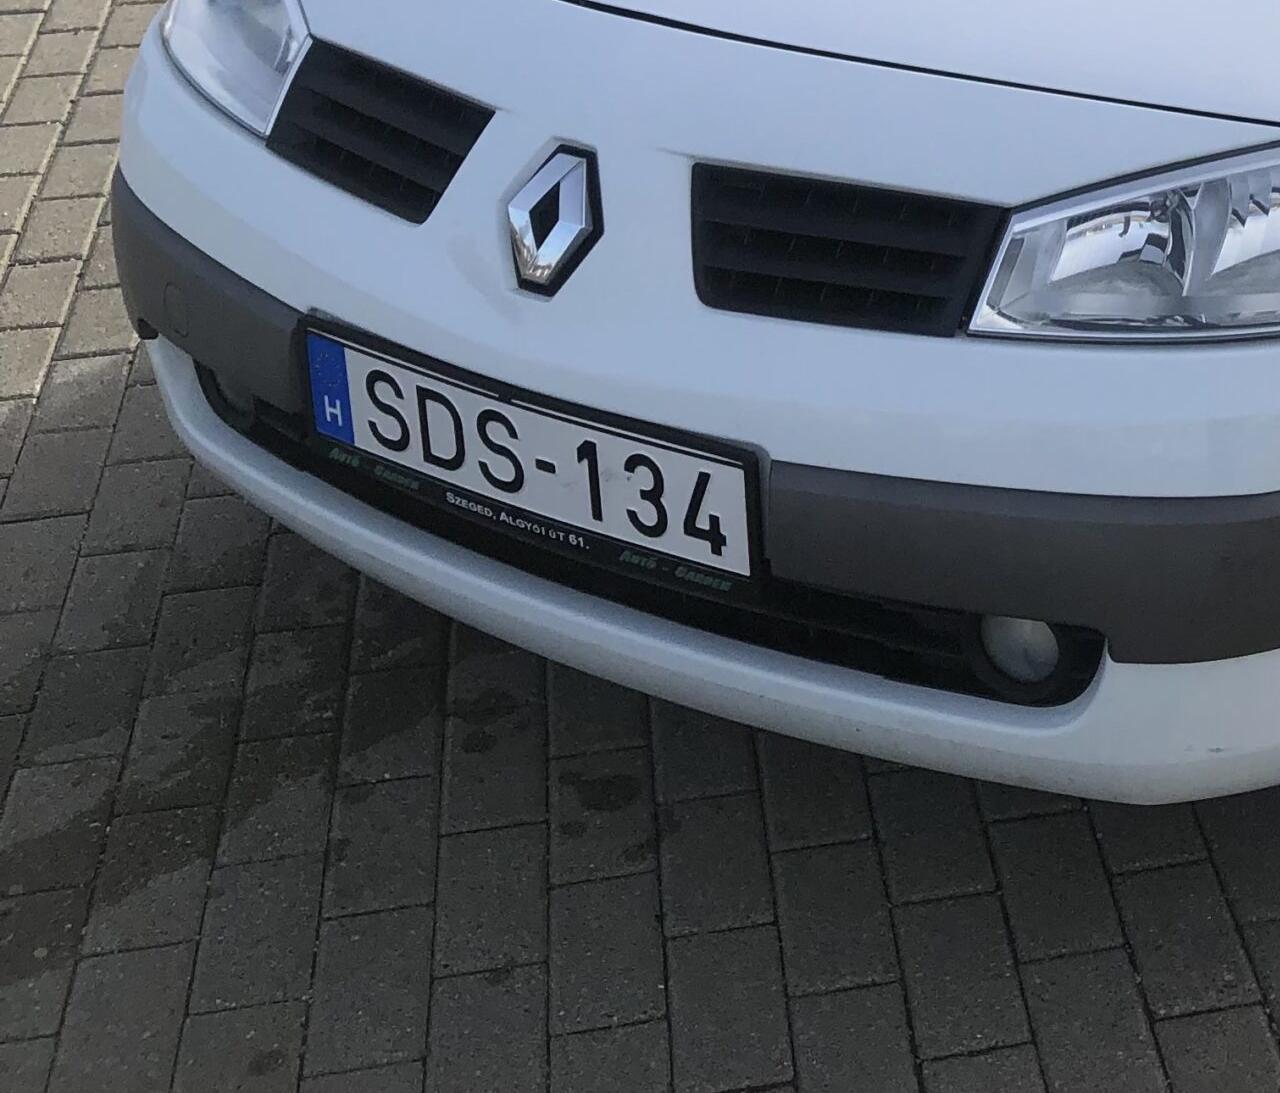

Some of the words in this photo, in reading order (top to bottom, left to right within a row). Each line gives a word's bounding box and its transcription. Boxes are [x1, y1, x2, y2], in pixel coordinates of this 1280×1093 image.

[323, 394, 344, 428] H
[364, 368, 728, 557] SDS-134
[568, 534, 591, 550] 61.
